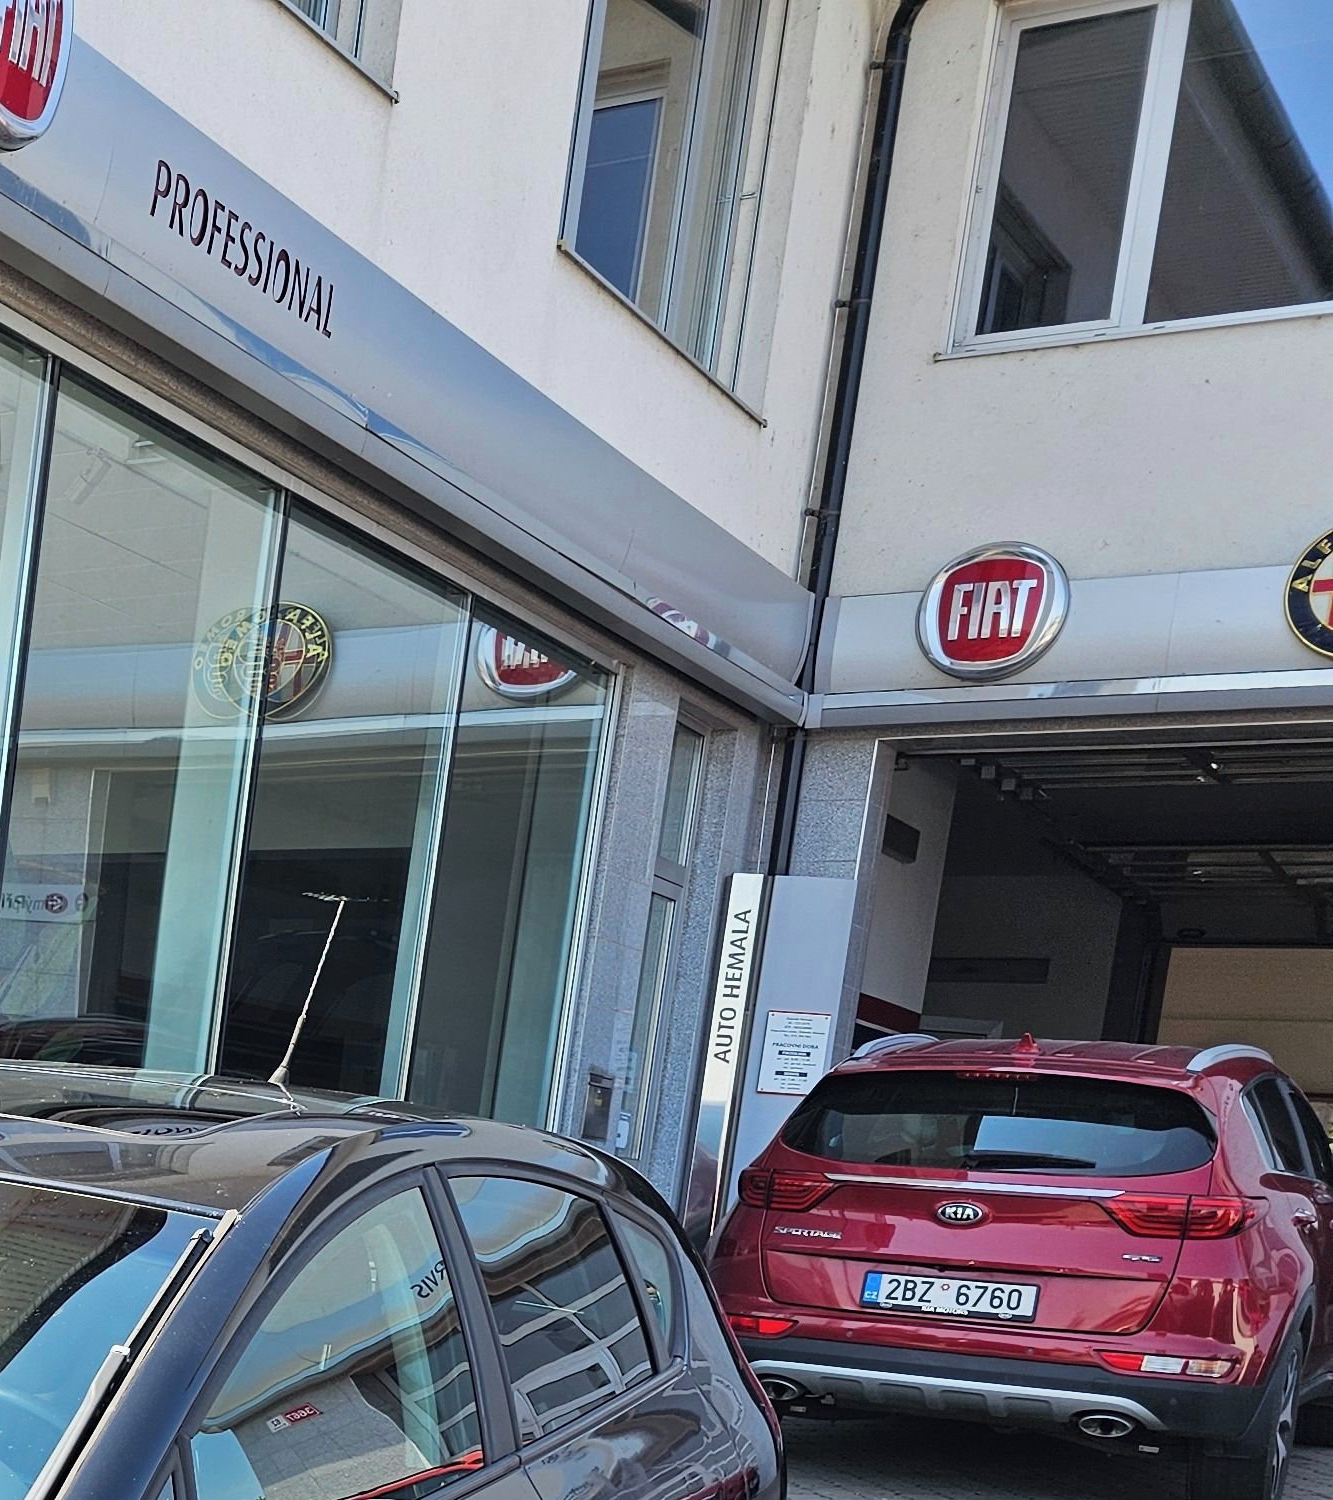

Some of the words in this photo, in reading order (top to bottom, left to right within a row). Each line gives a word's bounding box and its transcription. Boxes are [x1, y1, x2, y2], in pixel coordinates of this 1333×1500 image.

[149, 159, 334, 338] PROFESSIONAL
[948, 578, 1038, 641] FIAT
[723, 908, 752, 999] HEMALA
[714, 1007, 737, 1064] AUTO
[944, 1206, 975, 1220] KIA
[864, 1291, 878, 1299] CZ
[885, 1278, 935, 1303] 2BZ
[955, 1284, 1023, 1311] 6760
